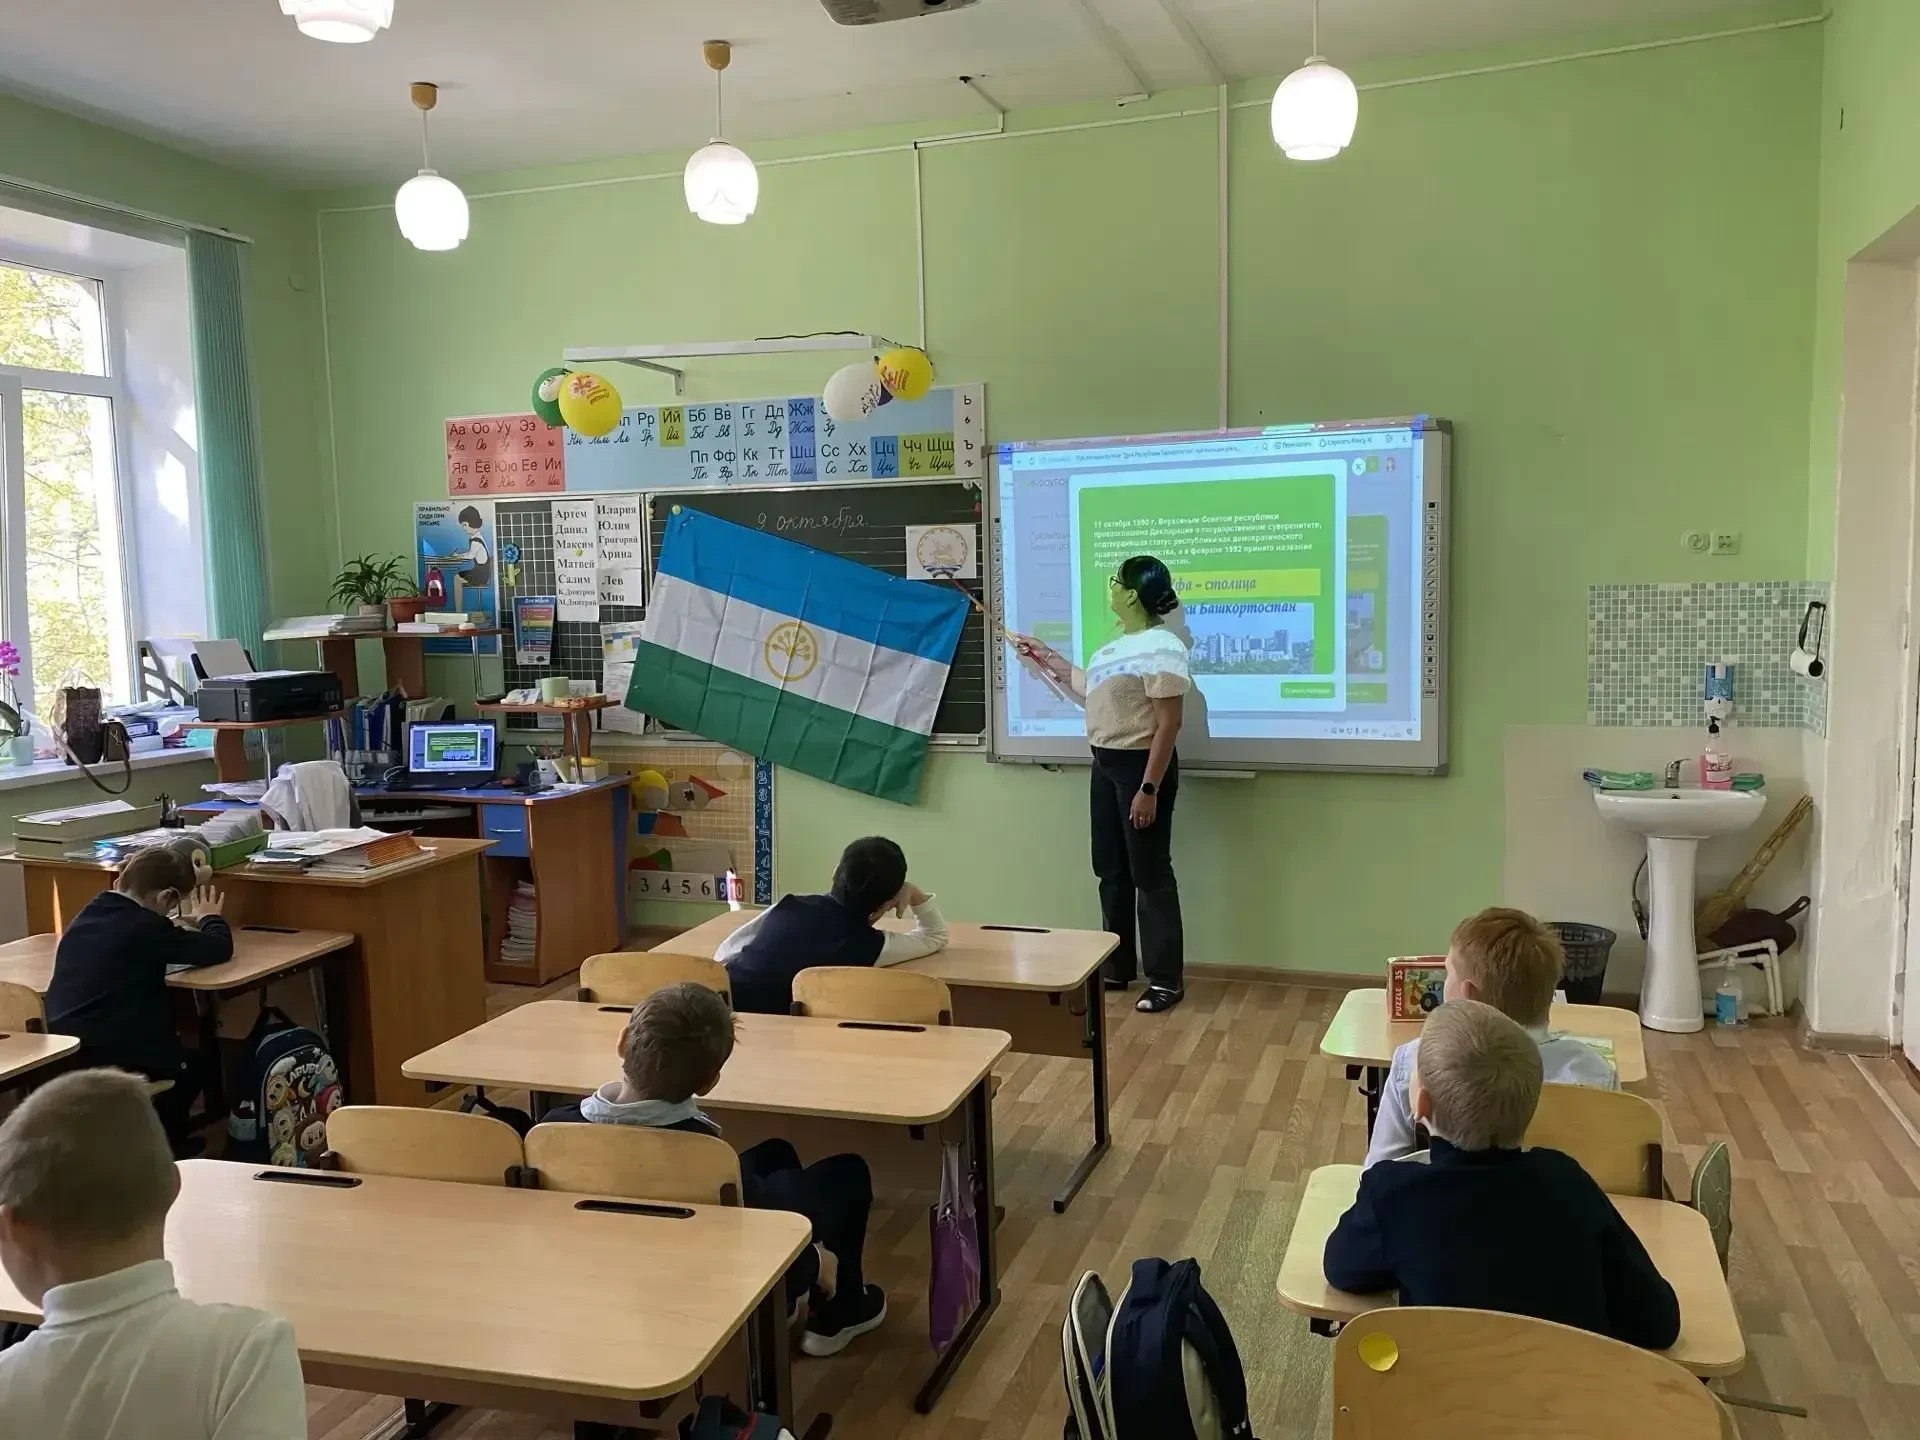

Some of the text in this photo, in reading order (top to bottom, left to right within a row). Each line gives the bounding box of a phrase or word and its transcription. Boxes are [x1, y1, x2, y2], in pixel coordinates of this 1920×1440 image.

[450, 424, 465, 435] Аа
[472, 423, 489, 434] Оо
[496, 421, 511, 435] Уу
[520, 420, 535, 431] Ээ
[638, 413, 654, 427] Рр
[663, 409, 680, 424] Йй
[689, 410, 706, 422] Бб
[715, 408, 731, 421] Вв
[742, 406, 755, 419] Гг
[765, 405, 784, 420] Дд
[789, 403, 813, 416] Жж
[452, 463, 468, 474] Яя
[475, 459, 490, 473] Ёё
[522, 459, 537, 471] Ее
[545, 458, 561, 470] Ии
[690, 450, 708, 463] Пп
[713, 449, 736, 464] Фф
[744, 448, 758, 460] Кк
[769, 447, 784, 459] Тт
[790, 446, 816, 458] Шш
[821, 444, 840, 457] Сс
[848, 442, 866, 456] Хх
[875, 441, 895, 456] Цц
[903, 440, 922, 452] Чч
[927, 438, 954, 453] Щщ
[555, 509, 587, 520] Артем
[597, 505, 636, 516] Илария
[598, 521, 630, 530] Юлия
[756, 512, 767, 530] 9
[1094, 520, 1102, 528] 11
[1104, 519, 1131, 528] октября
[1158, 517, 1200, 526] Верховным
[1234, 513, 1279, 523] республики
[555, 525, 587, 535] Данил
[1150, 528, 1193, 537] Декларация
[556, 540, 594, 549] Максим
[598, 536, 638, 546] Григорий
[1149, 539, 1171, 548] статус
[1174, 537, 1216, 546] республики
[1233, 534, 1303, 543] демократического
[600, 550, 632, 560] Арина
[1190, 547, 1222, 556] феврале
[1244, 546, 1274, 555] принято
[558, 559, 595, 568] Матвей
[558, 574, 591, 584] Салим
[602, 576, 624, 586] Лев
[1205, 578, 1256, 592] столица
[600, 592, 624, 601] Мия
[1200, 602, 1297, 618] Башкортостан
[640, 877, 649, 892] 3
[662, 878, 671, 893] 4
[681, 880, 691, 894] 5
[701, 879, 710, 895] 6
[720, 883, 726, 897] 9
